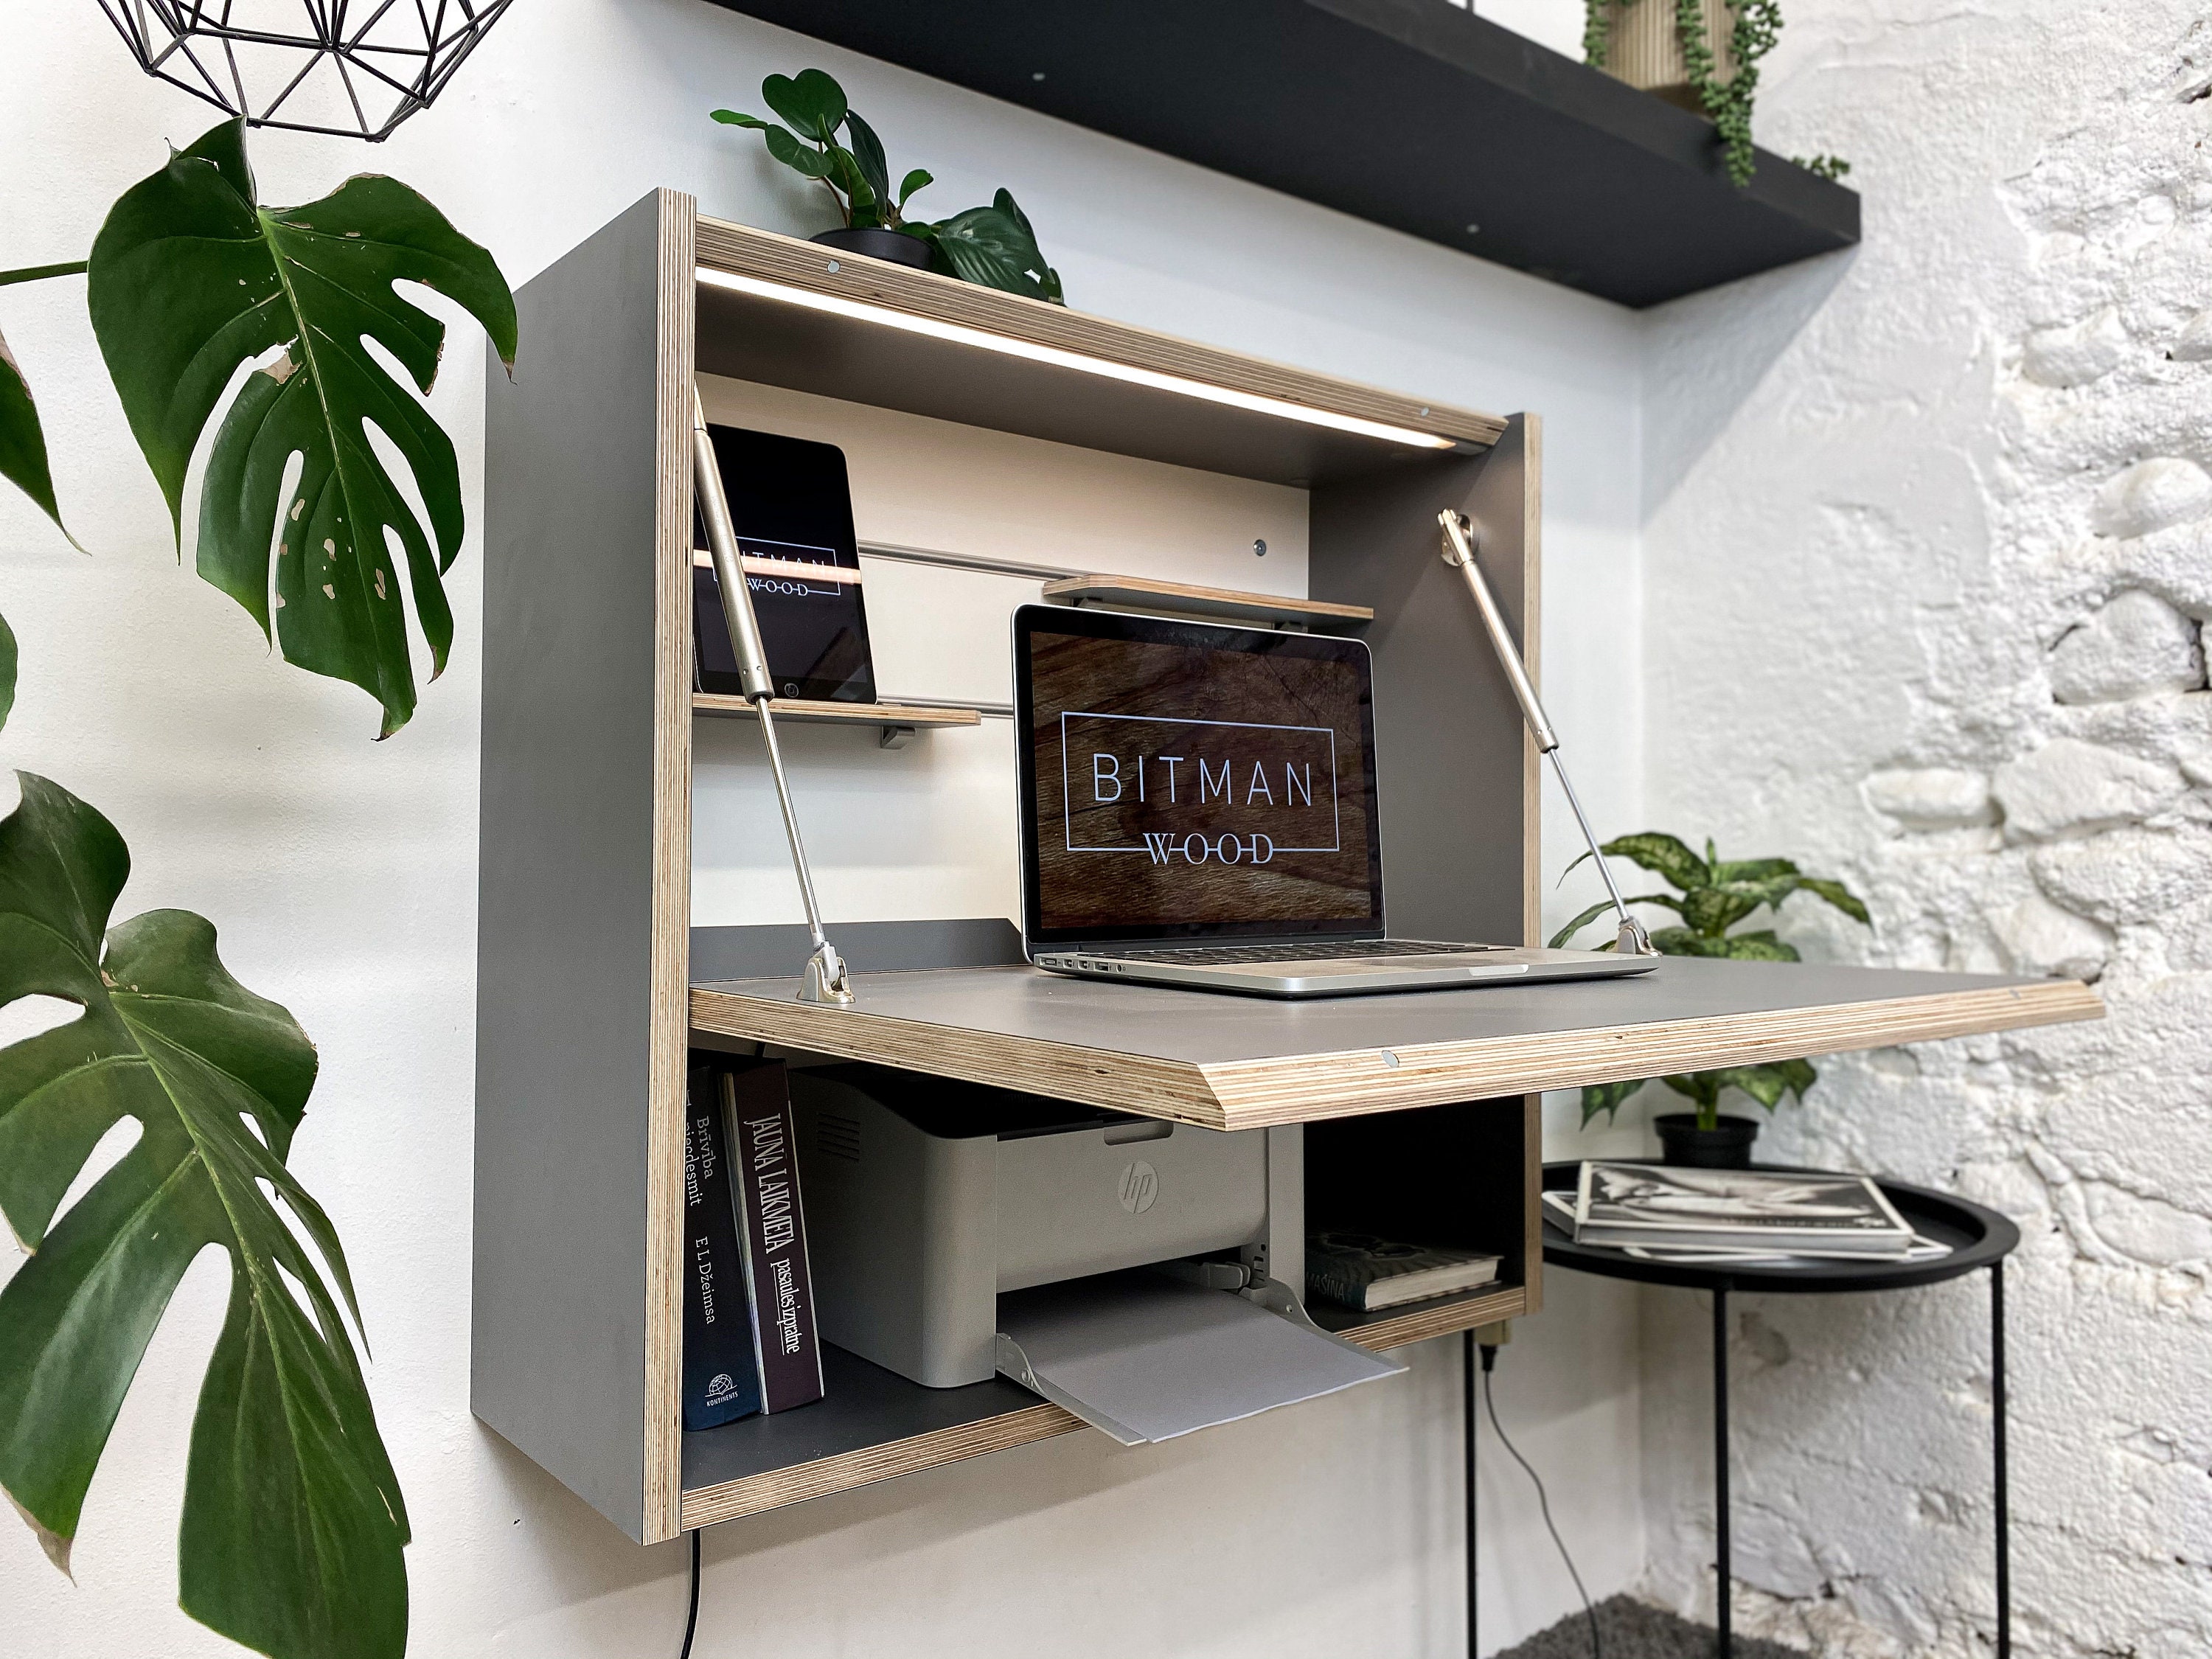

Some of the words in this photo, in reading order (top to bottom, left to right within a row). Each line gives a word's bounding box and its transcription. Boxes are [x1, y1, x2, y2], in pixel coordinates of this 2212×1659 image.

[742, 550, 827, 574] ITMAN
[747, 577, 809, 597] WOOD
[1093, 753, 1312, 807] BITMAN
[1143, 832, 1274, 866] WOOD
[697, 1116, 717, 1179] Brīvība
[743, 1113, 787, 1171] JAUNĀ
[758, 1168, 795, 1254] LAIKMETA
[1123, 1162, 1152, 1214] hp
[696, 1236, 709, 1248] E
[698, 1249, 709, 1260] L
[699, 1262, 715, 1324] Džeimsa
[770, 1258, 800, 1308] pasaules
[776, 1304, 803, 1354] izpratne
[706, 1391, 738, 1407] KONTINENTS
